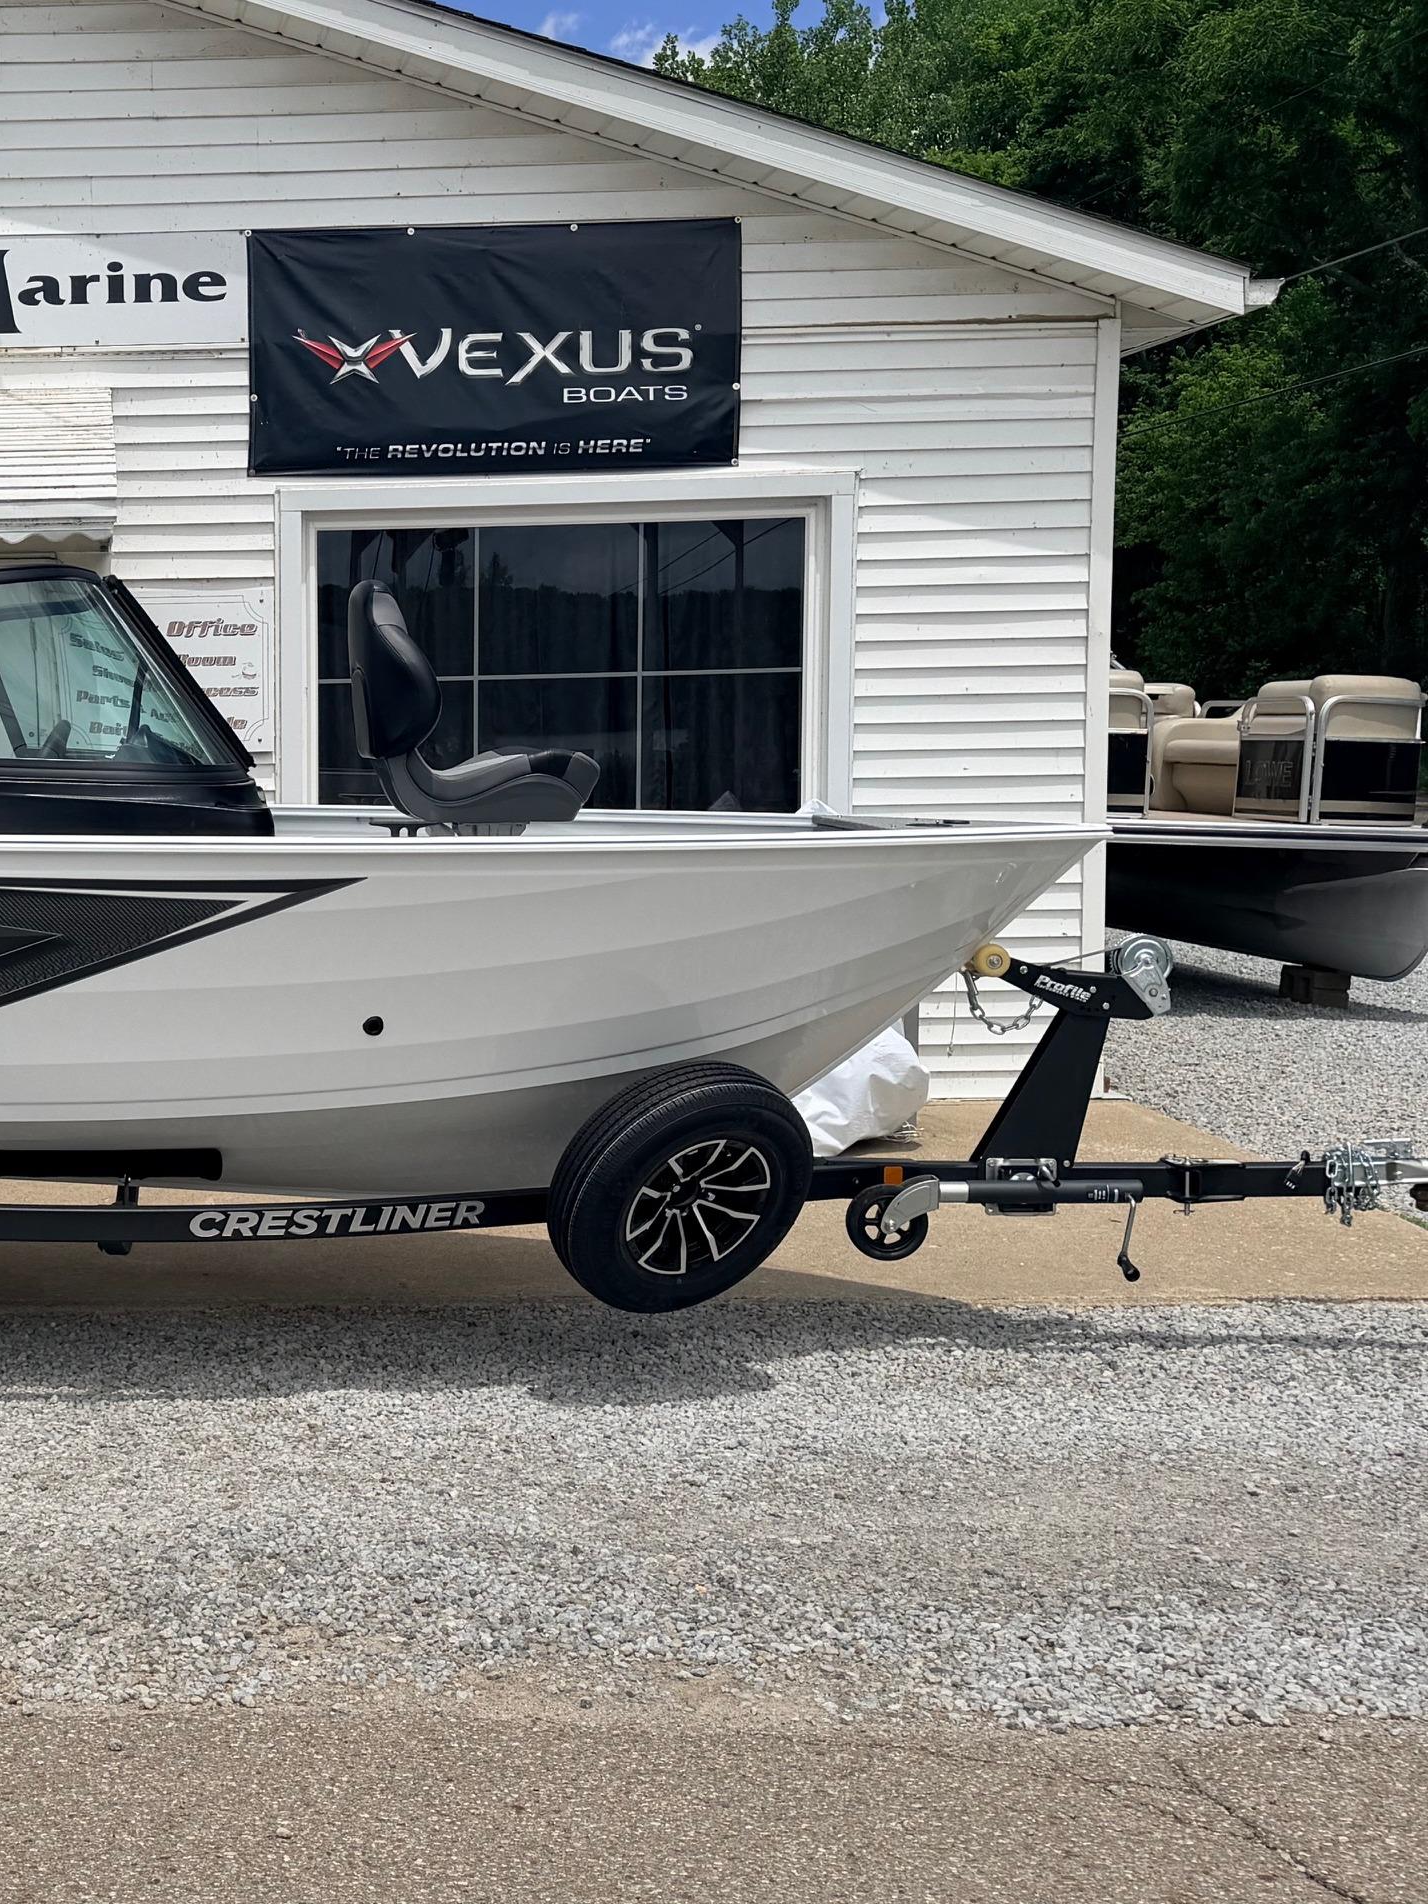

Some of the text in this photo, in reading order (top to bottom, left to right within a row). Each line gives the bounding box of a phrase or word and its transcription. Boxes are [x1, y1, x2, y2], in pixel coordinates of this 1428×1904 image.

[563, 385, 688, 404] BOATS
[387, 441, 546, 459] REVOLUTION
[553, 443, 571, 455] IS
[166, 618, 258, 638] Office
[76, 690, 130, 709] Parts
[1034, 974, 1092, 1001] Profile
[189, 1200, 485, 1238] CRESTLINER
